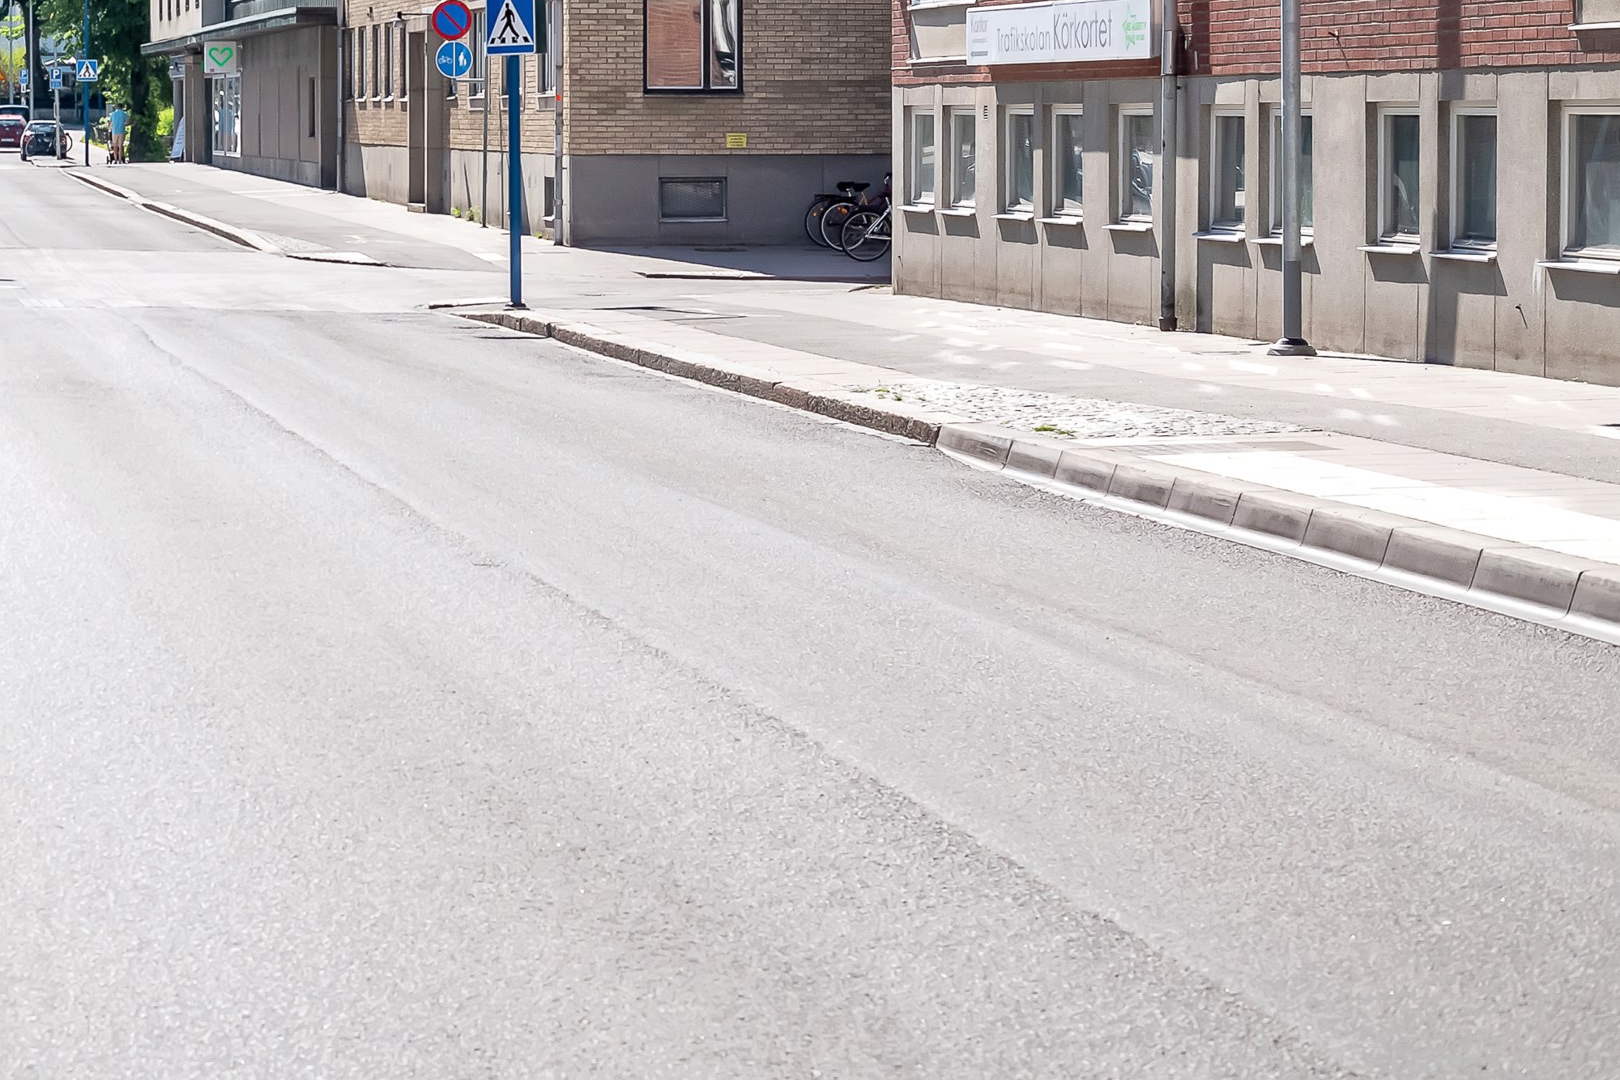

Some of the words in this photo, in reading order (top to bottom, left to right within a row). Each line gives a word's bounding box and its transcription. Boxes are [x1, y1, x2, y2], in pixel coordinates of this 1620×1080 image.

[997, 25, 1051, 53] Trafikskolan
[1053, 9, 1113, 50] Körkortet
[52, 70, 59, 79] P
